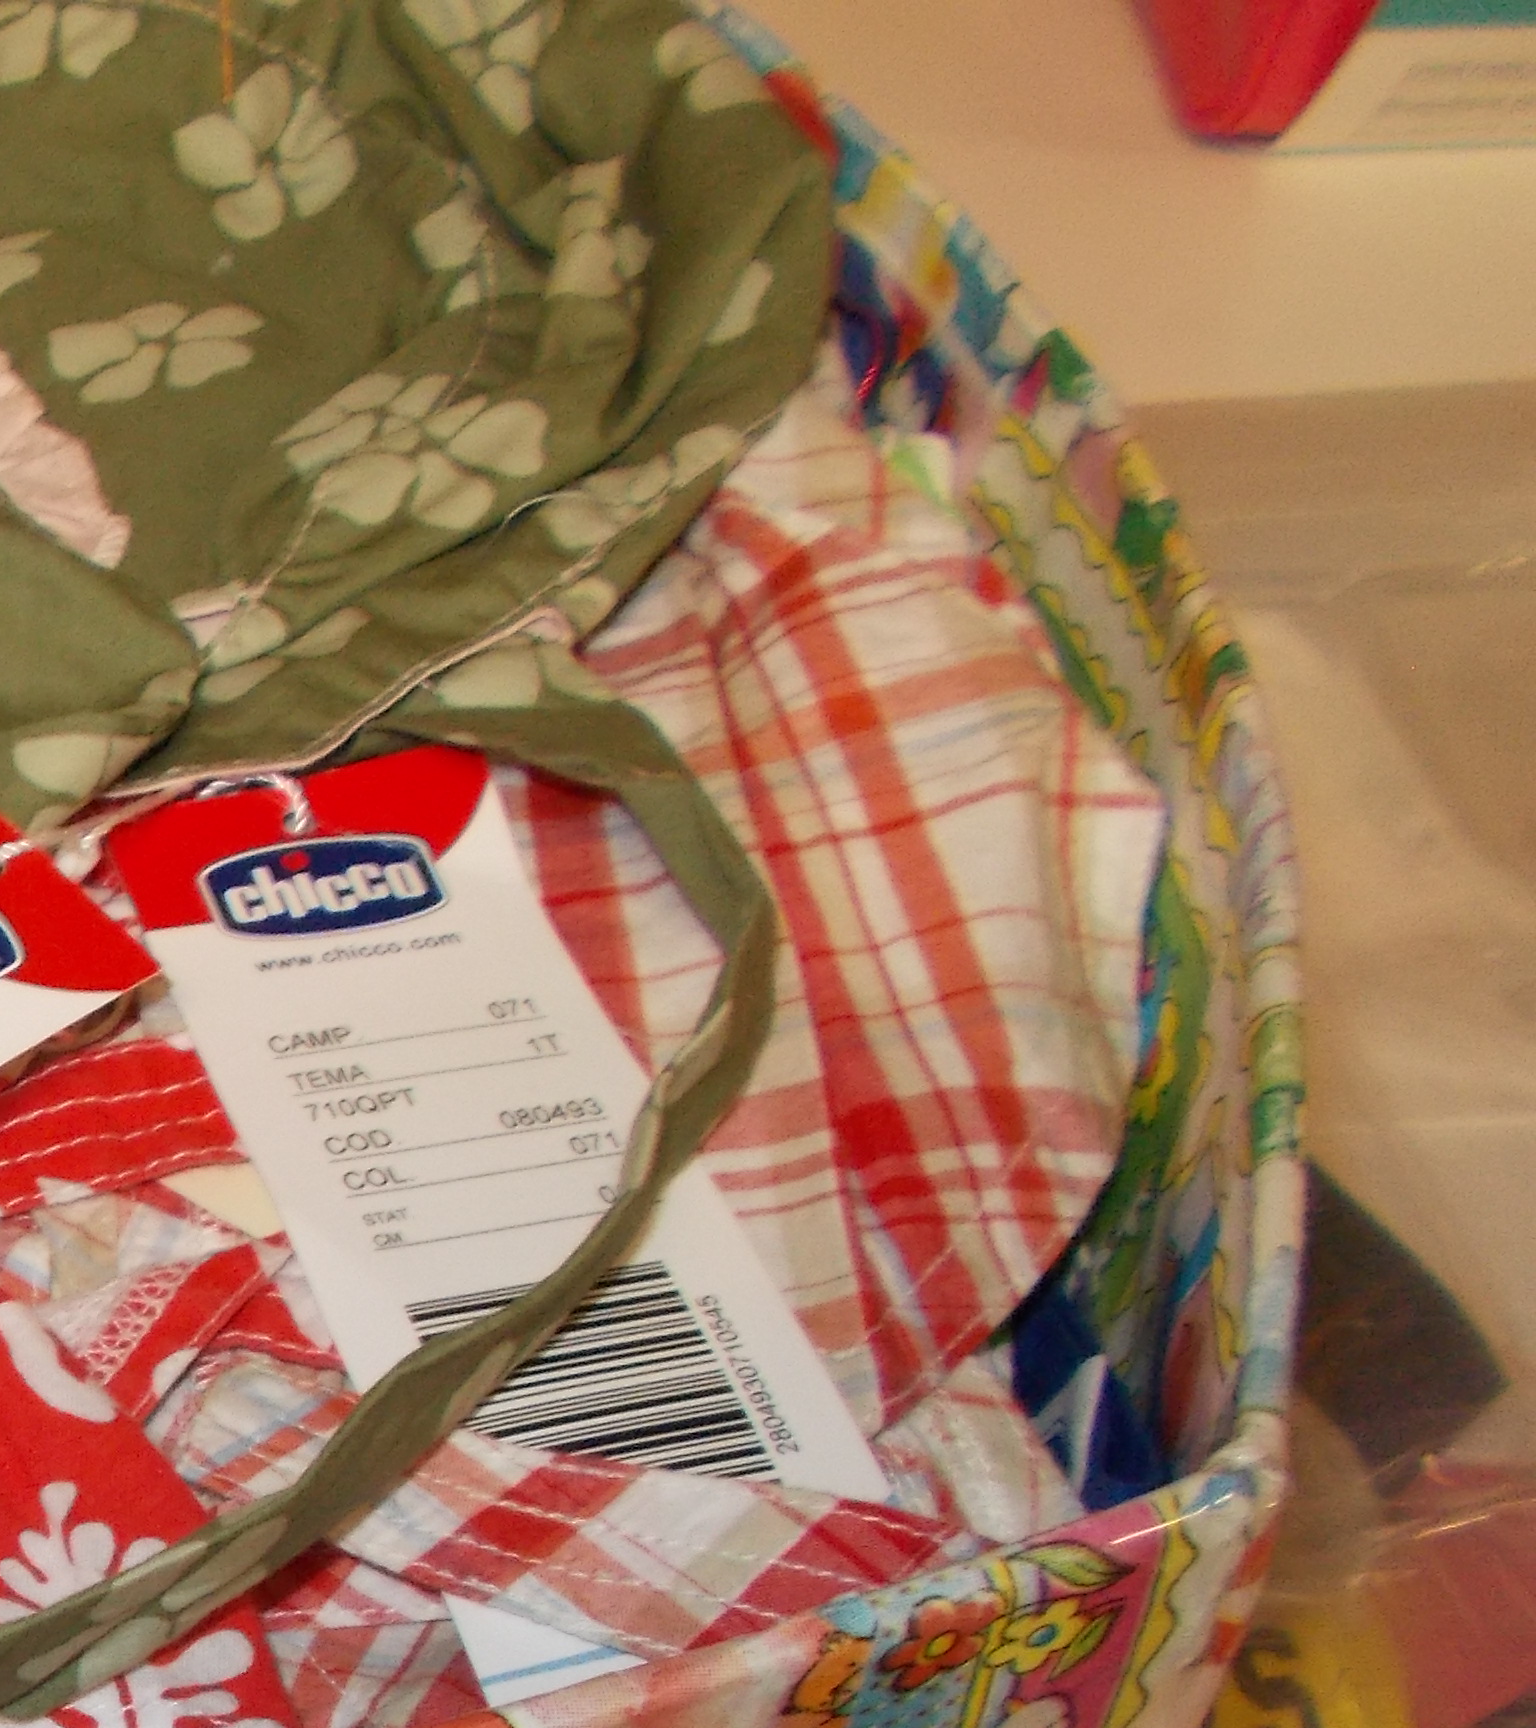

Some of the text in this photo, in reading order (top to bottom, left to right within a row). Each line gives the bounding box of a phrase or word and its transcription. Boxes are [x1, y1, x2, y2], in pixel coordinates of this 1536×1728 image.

[254, 930, 462, 973] www.chicco.com
[487, 998, 537, 1020] 071
[286, 1033, 560, 1091] TEMA 1T
[498, 1097, 604, 1129] 080493
[568, 1131, 621, 1155] 071
[696, 1294, 801, 1455] 2804930710545
